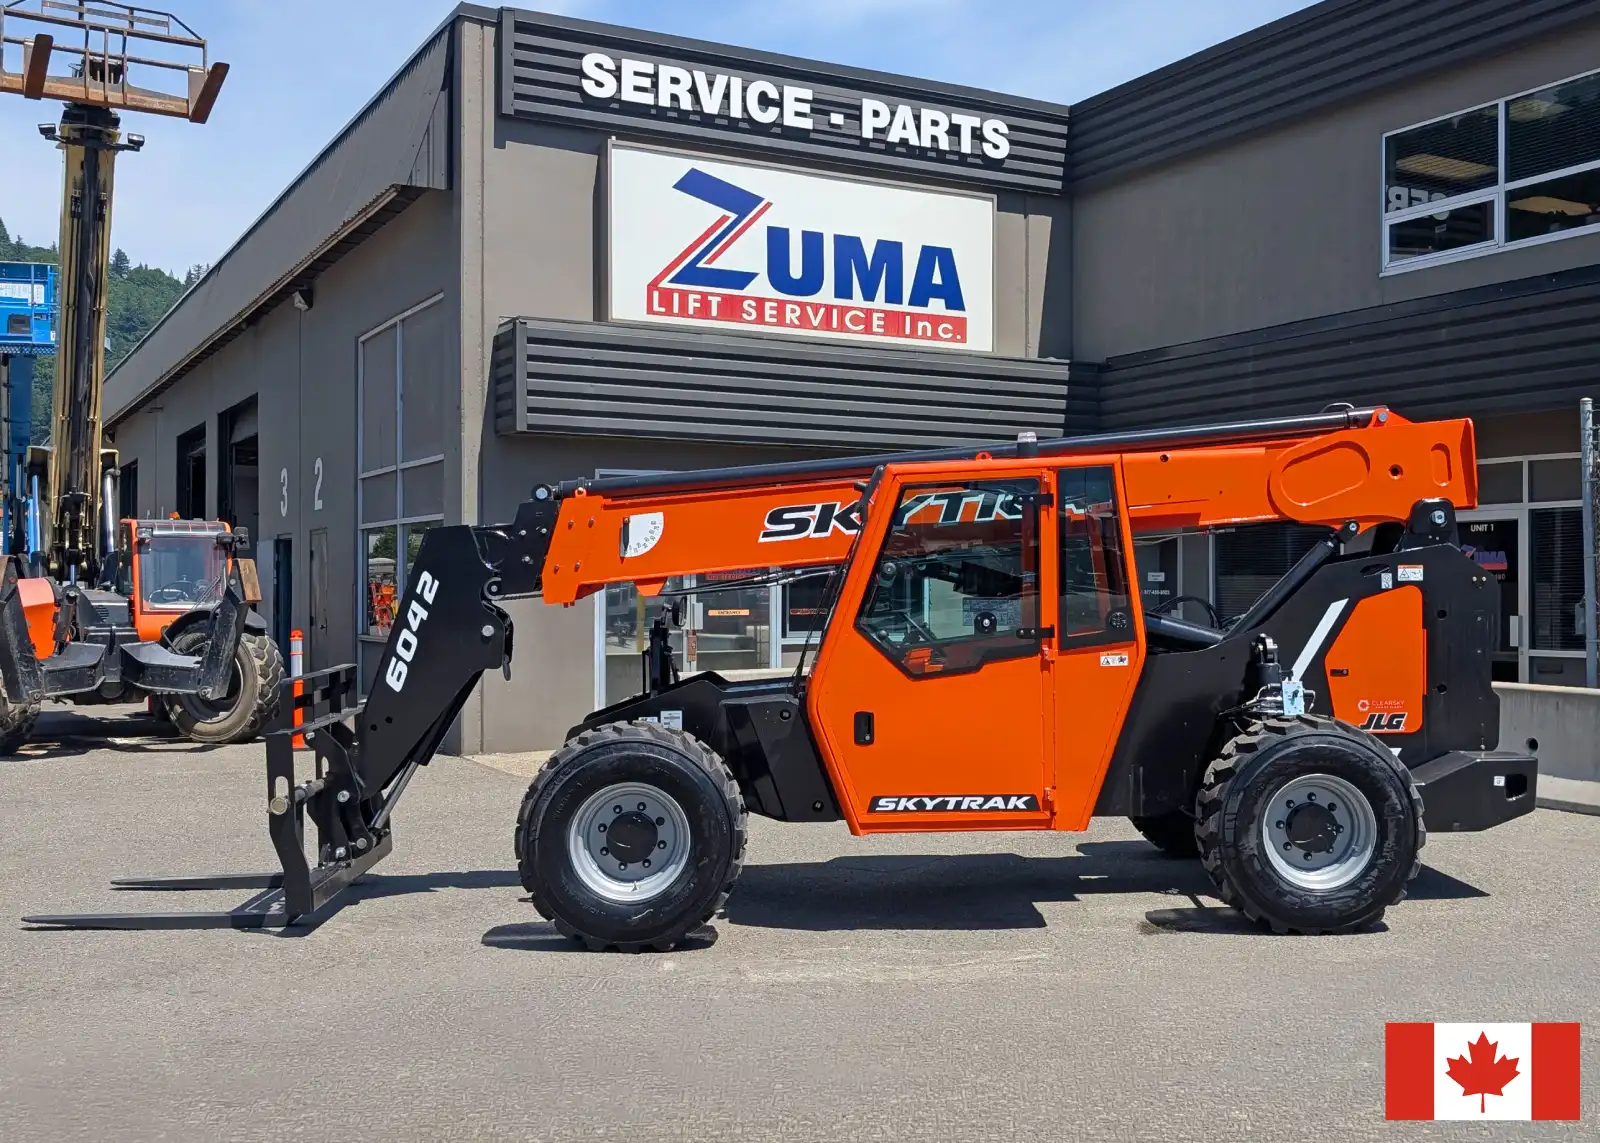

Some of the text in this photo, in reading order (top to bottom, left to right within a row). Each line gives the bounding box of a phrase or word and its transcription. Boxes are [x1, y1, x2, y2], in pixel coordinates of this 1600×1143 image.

[581, 53, 814, 130] SERVICE
[861, 98, 1010, 159] PARTS
[650, 167, 966, 312] ZUMA
[653, 290, 962, 340] LIFT SERVICE Inc.
[280, 467, 288, 517] 3
[314, 457, 323, 511] 2
[1470, 523, 1495, 533] UNIT 1
[386, 570, 440, 693] 6042
[1358, 711, 1408, 732] JLG
[875, 796, 1032, 812] SKYTRAK
